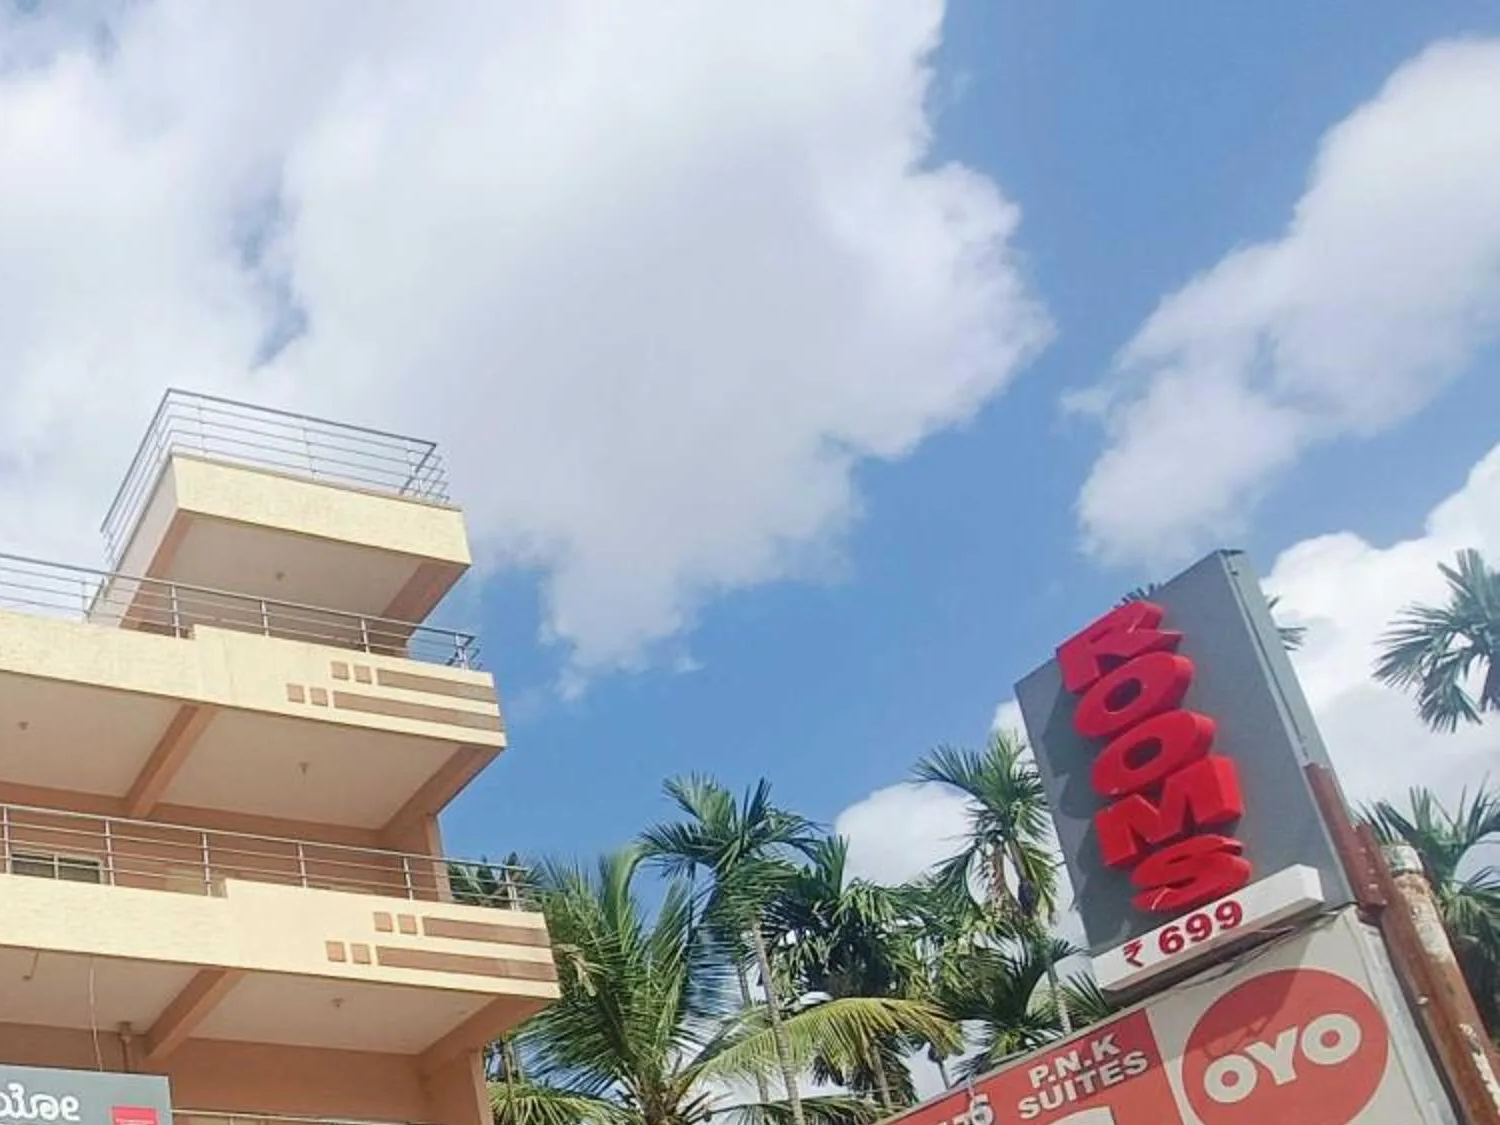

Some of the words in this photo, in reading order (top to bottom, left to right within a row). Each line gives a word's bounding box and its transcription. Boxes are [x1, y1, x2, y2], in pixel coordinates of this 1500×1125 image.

[1056, 600, 1252, 915] ROOMS
[1159, 901, 1244, 955] 699
[1017, 1051, 1149, 1119] SUITES
[1029, 1033, 1122, 1088] P.N.K
[1203, 1013, 1361, 1103] OYO
